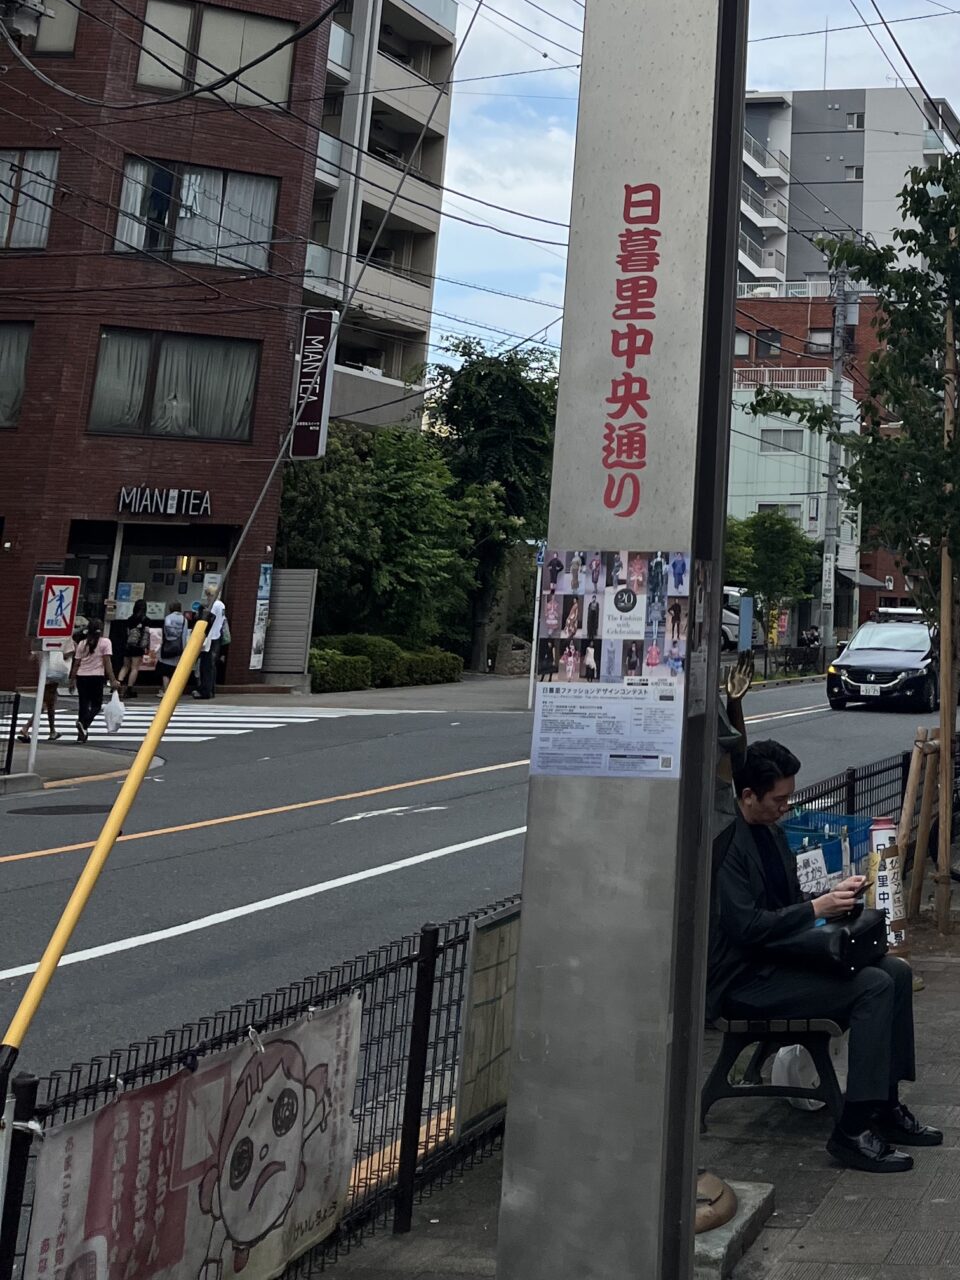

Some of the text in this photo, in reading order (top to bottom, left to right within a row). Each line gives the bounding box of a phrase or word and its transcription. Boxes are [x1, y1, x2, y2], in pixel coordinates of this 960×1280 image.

[602, 183, 662, 518] 日暮里中央通り
[181, 489, 211, 516] TEA
